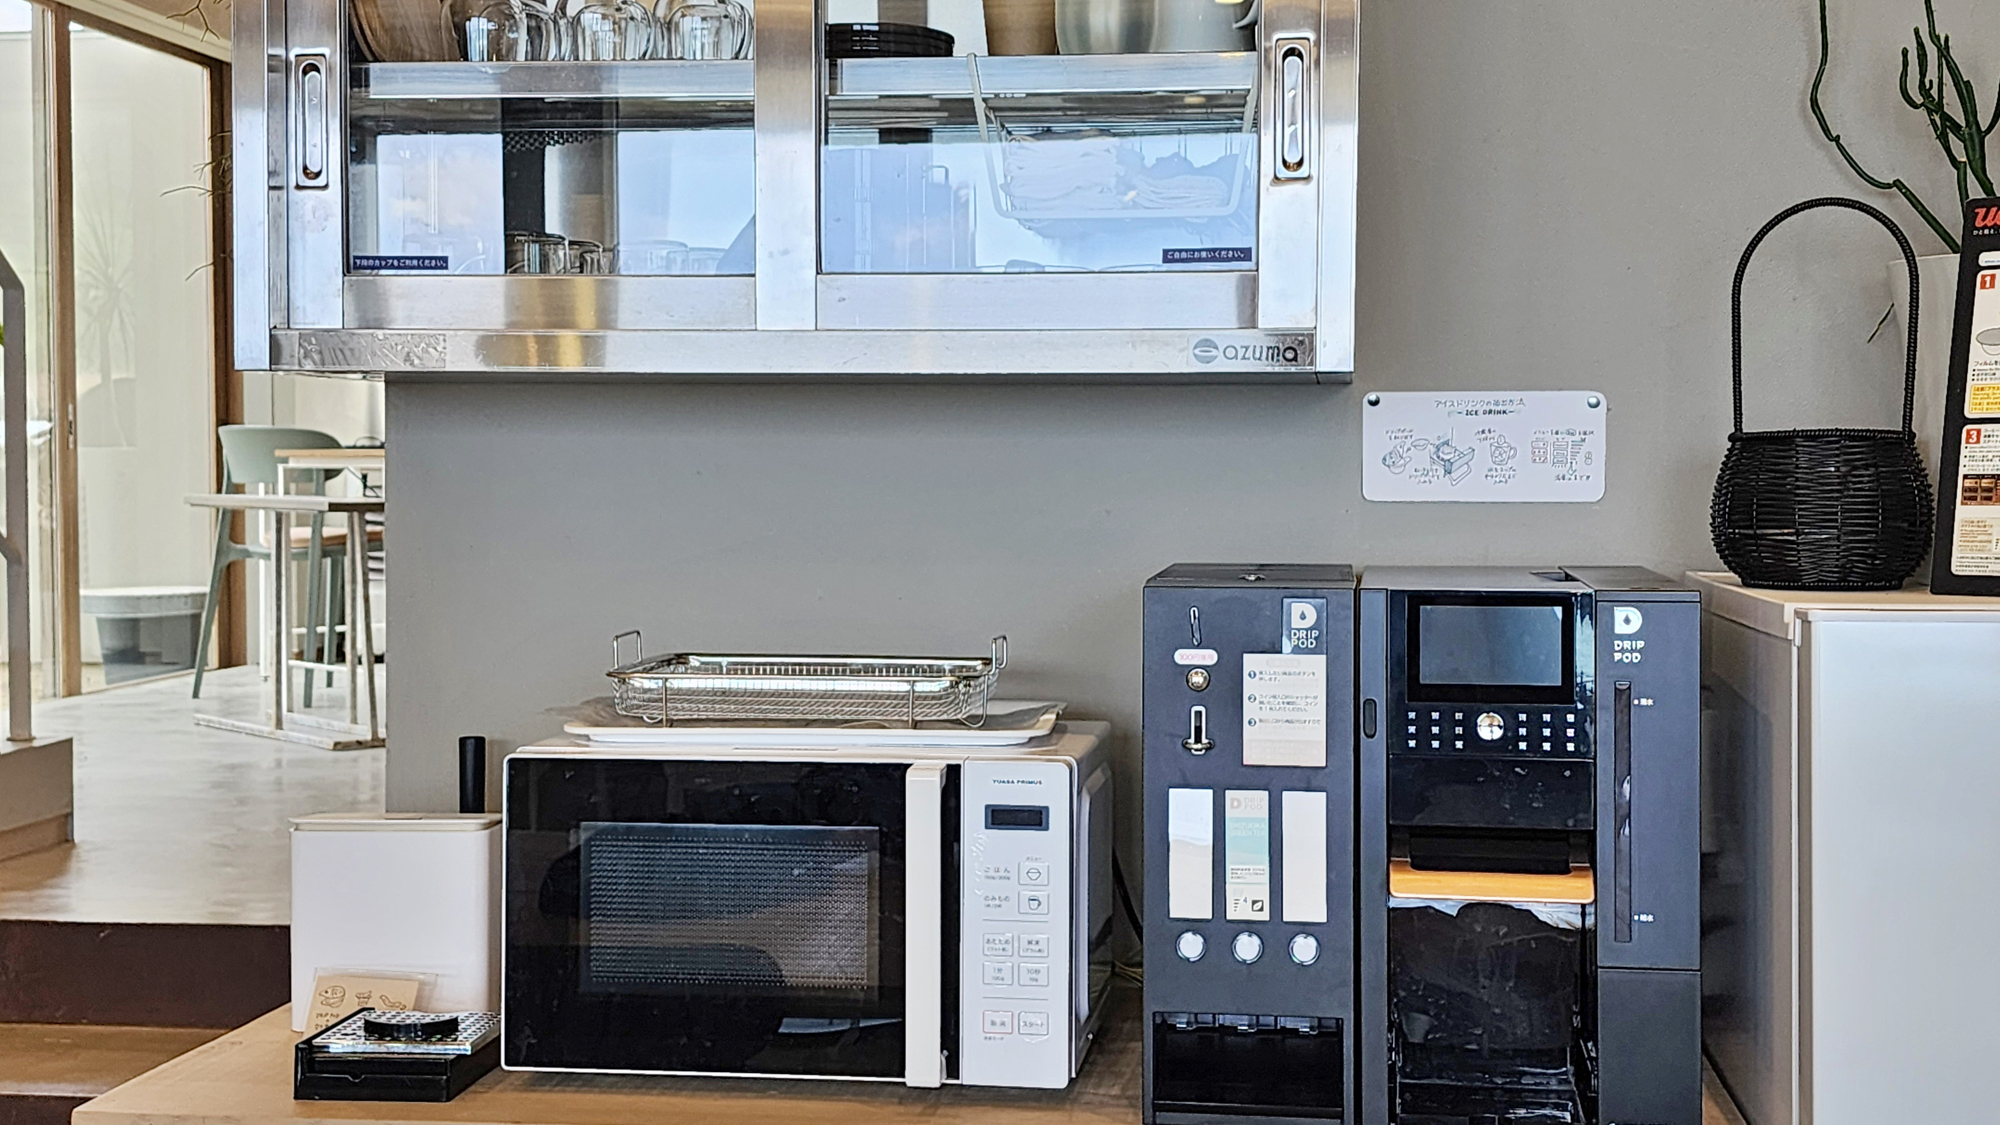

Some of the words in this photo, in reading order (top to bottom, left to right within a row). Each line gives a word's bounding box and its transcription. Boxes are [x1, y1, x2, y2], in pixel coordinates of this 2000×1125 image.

[1974, 206, 2000, 228] U
[1166, 249, 1245, 259] ご自由にお使いください。
[1222, 344, 1299, 363] azuma
[1968, 430, 1978, 443] 3
[1290, 629, 1320, 640] DRIP
[1290, 640, 1317, 649] POD
[1613, 640, 1645, 651] DRIP
[1613, 652, 1642, 663] POD
[1244, 803, 1263, 811] POD
[1022, 1020, 1045, 1028] スタート
